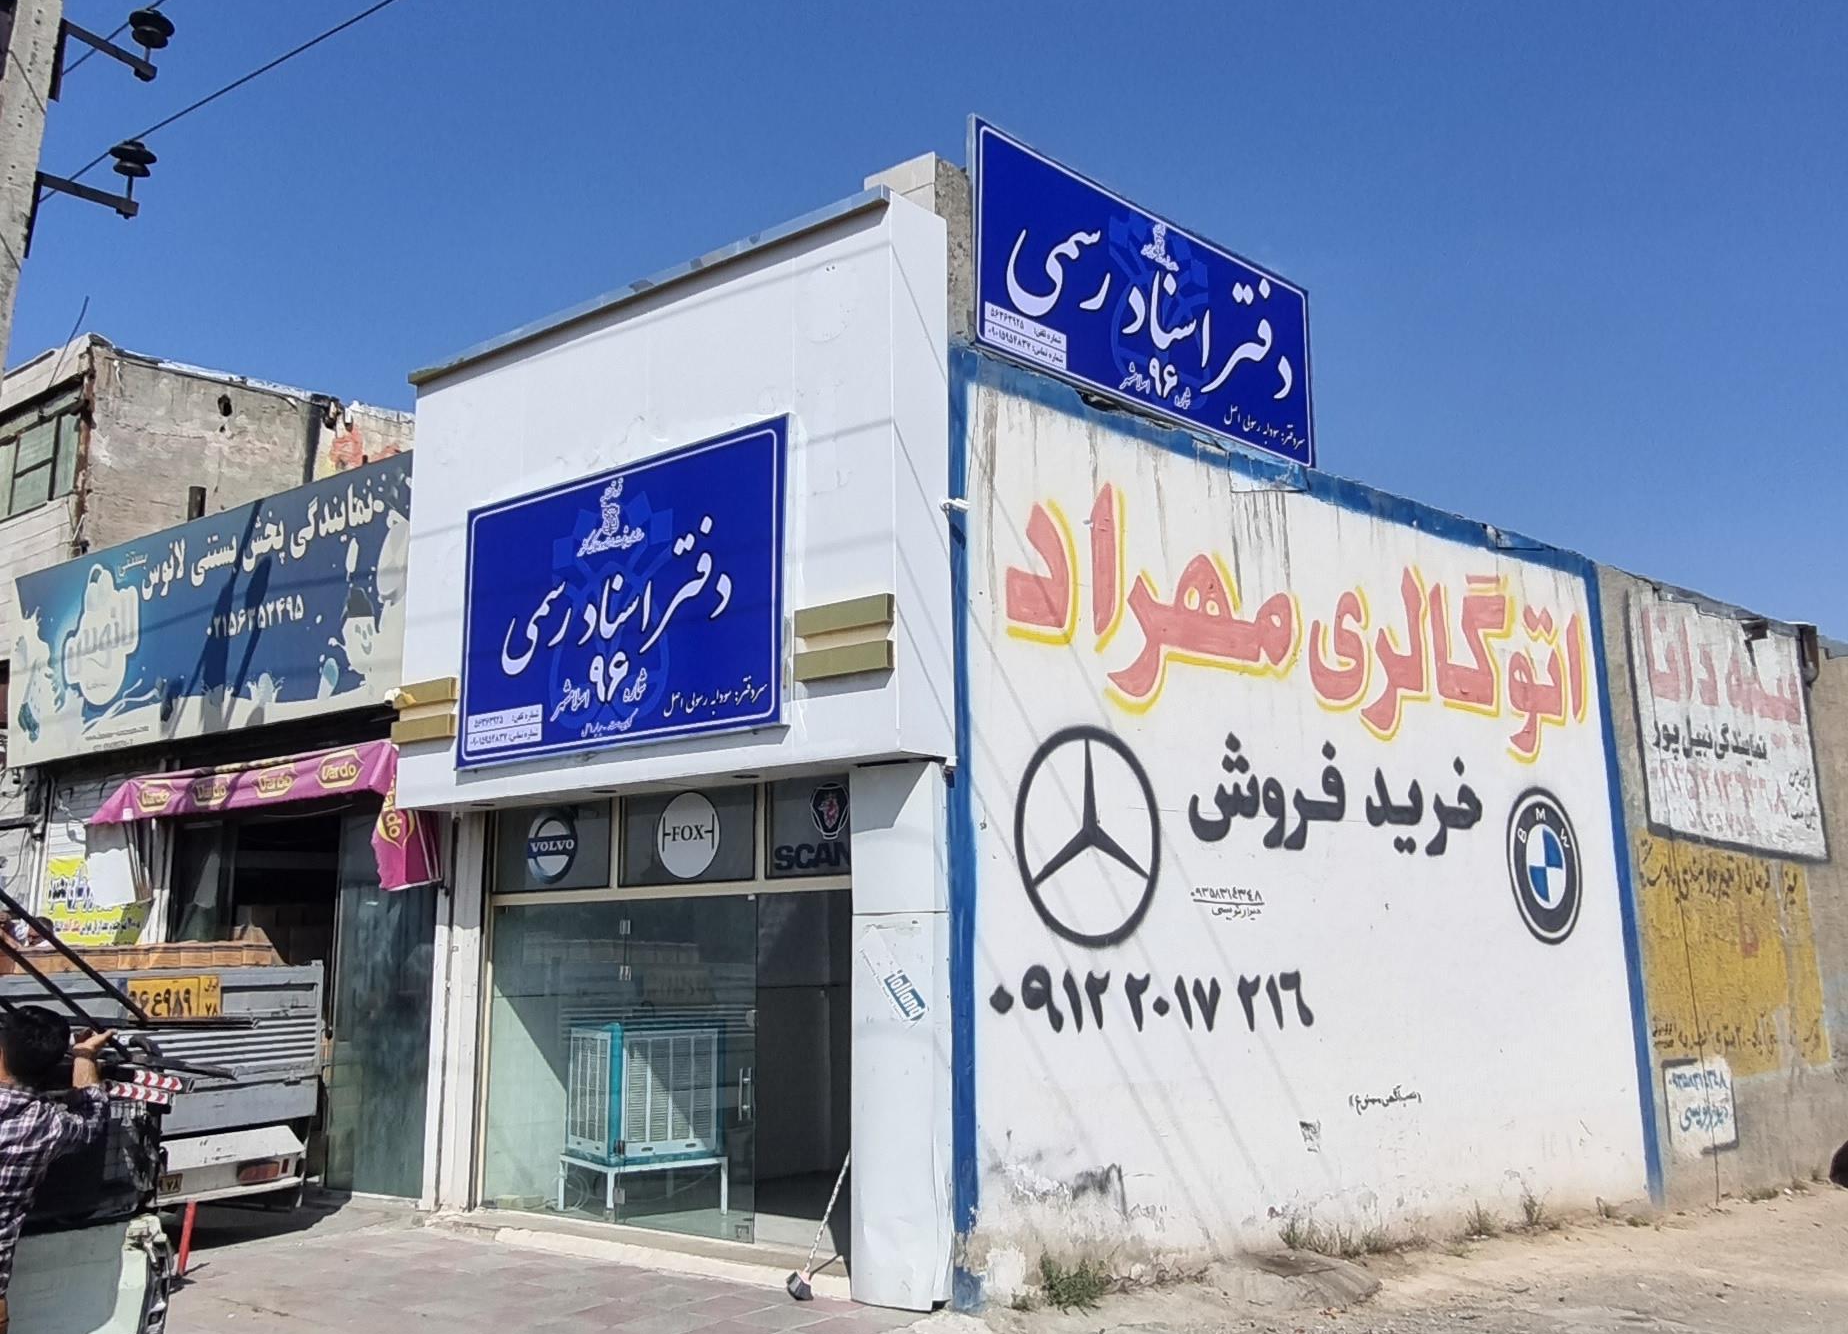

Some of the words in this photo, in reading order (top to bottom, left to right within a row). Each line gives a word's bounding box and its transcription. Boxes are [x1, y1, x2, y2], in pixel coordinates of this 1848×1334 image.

[1006, 228, 1111, 317] رسمی
[1122, 271, 1210, 368] اسناد
[1201, 278, 1293, 399] دفتر
[1149, 357, 1178, 398] ۹۶
[242, 510, 286, 573] پخش
[290, 482, 378, 559] نمایندگی
[141, 538, 186, 601] لانوس
[191, 534, 237, 587] بستنی
[640, 516, 733, 654] دفتر
[1005, 482, 1302, 711] مهراد
[501, 580, 572, 676] رسمی
[578, 573, 652, 645] اسناد
[589, 651, 629, 702] ۹۶
[1188, 732, 1345, 851] فروش
[1364, 757, 1482, 857] خرید
[530, 838, 576, 854] VOLVO
[671, 824, 705, 842] FOX
[205, 1002, 218, 1017] ۷۸
[989, 964, 1111, 1034] ۰۹۱۲
[1124, 972, 1221, 1033] ۲۰۱۷
